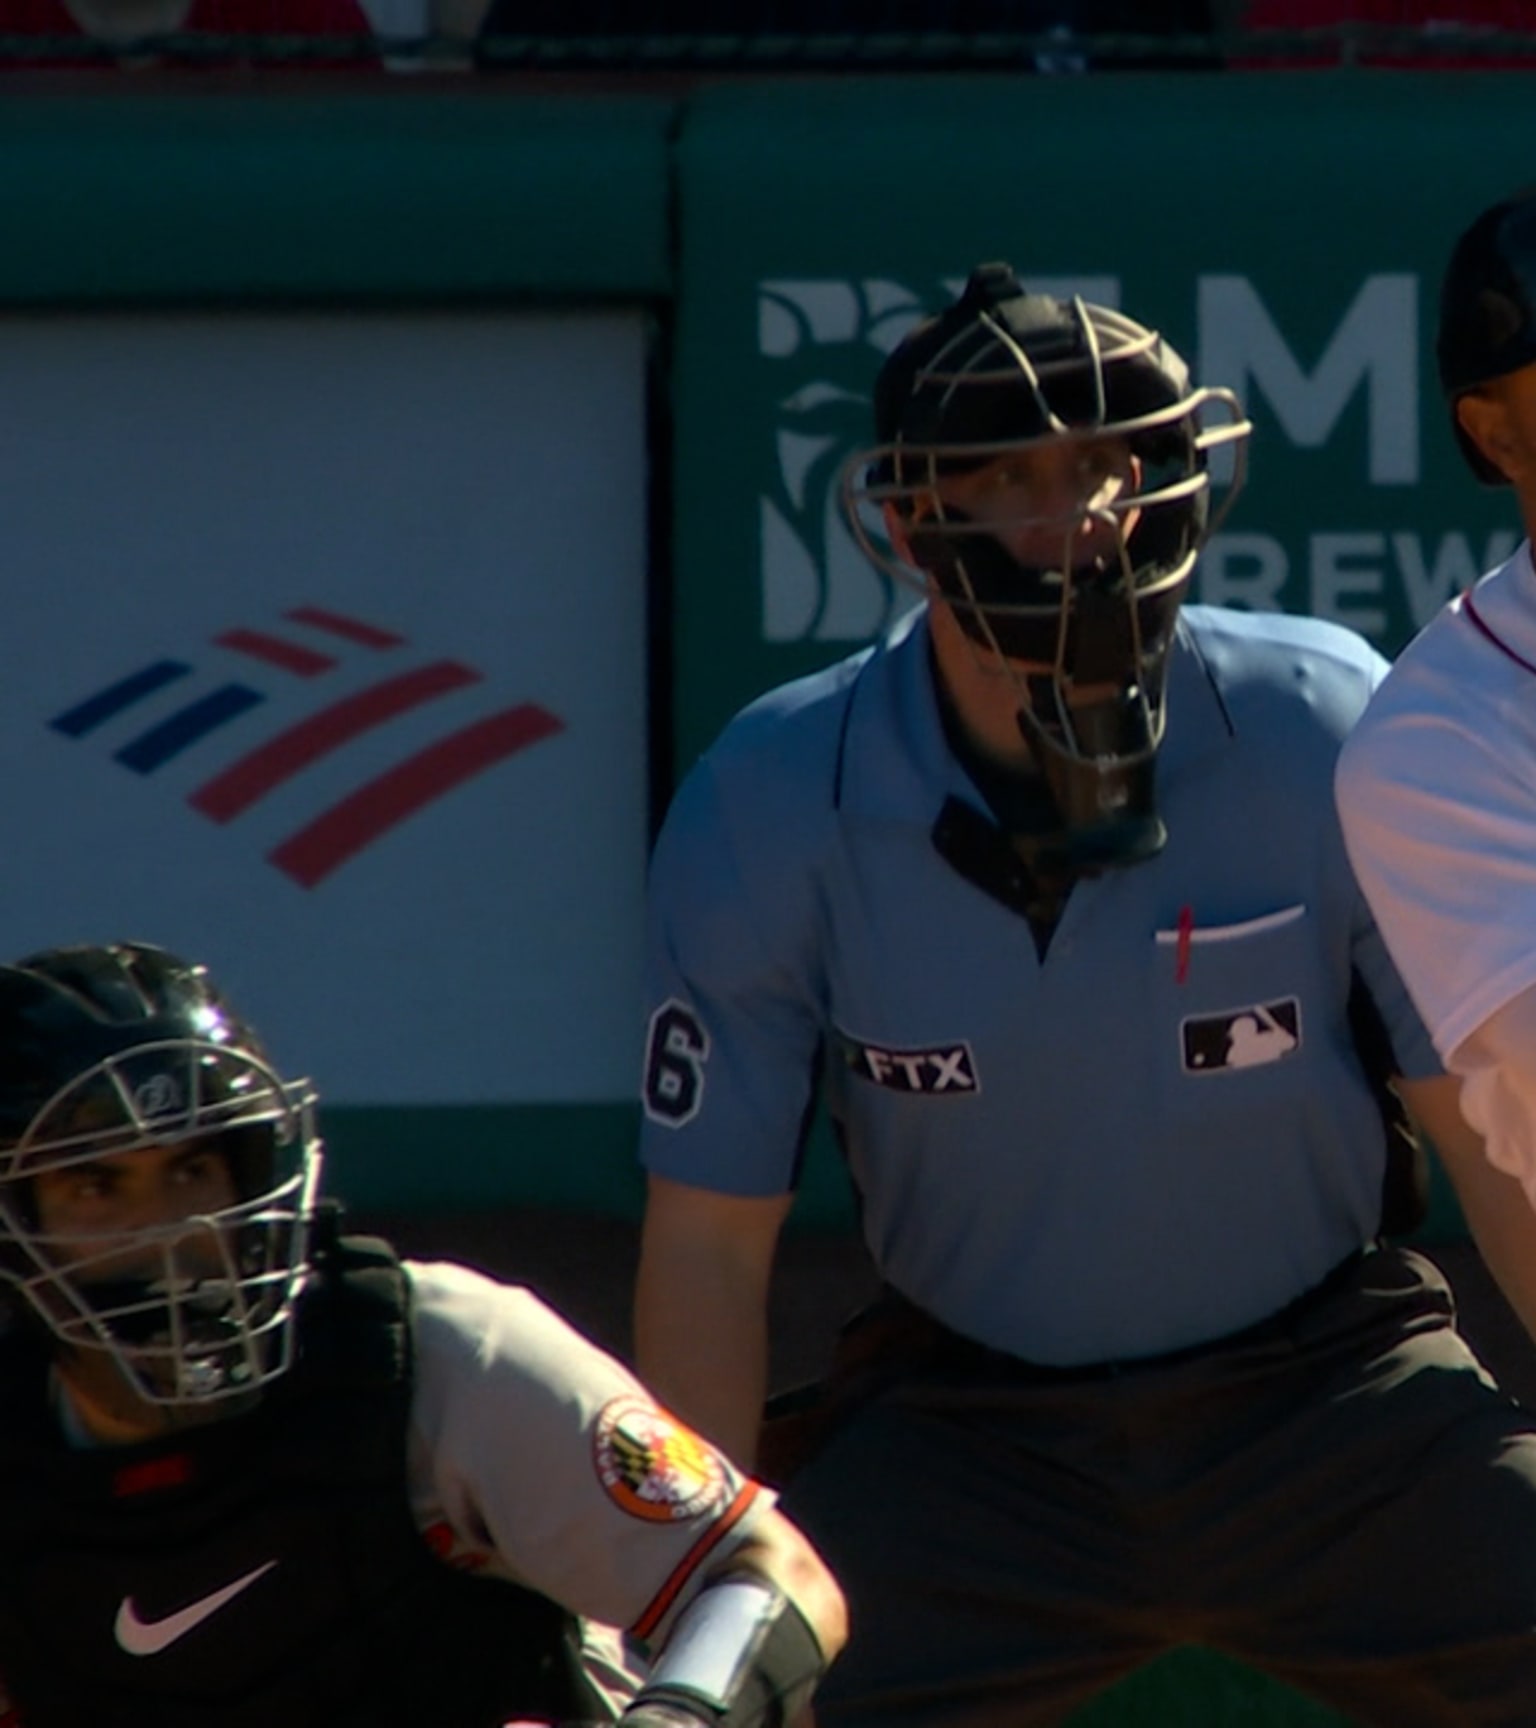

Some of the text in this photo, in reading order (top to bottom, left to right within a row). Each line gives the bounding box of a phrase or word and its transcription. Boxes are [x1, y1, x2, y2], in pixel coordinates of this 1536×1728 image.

[1200, 530, 1520, 636] REW
[643, 1000, 709, 1127] 6
[863, 1047, 973, 1091] FTX
